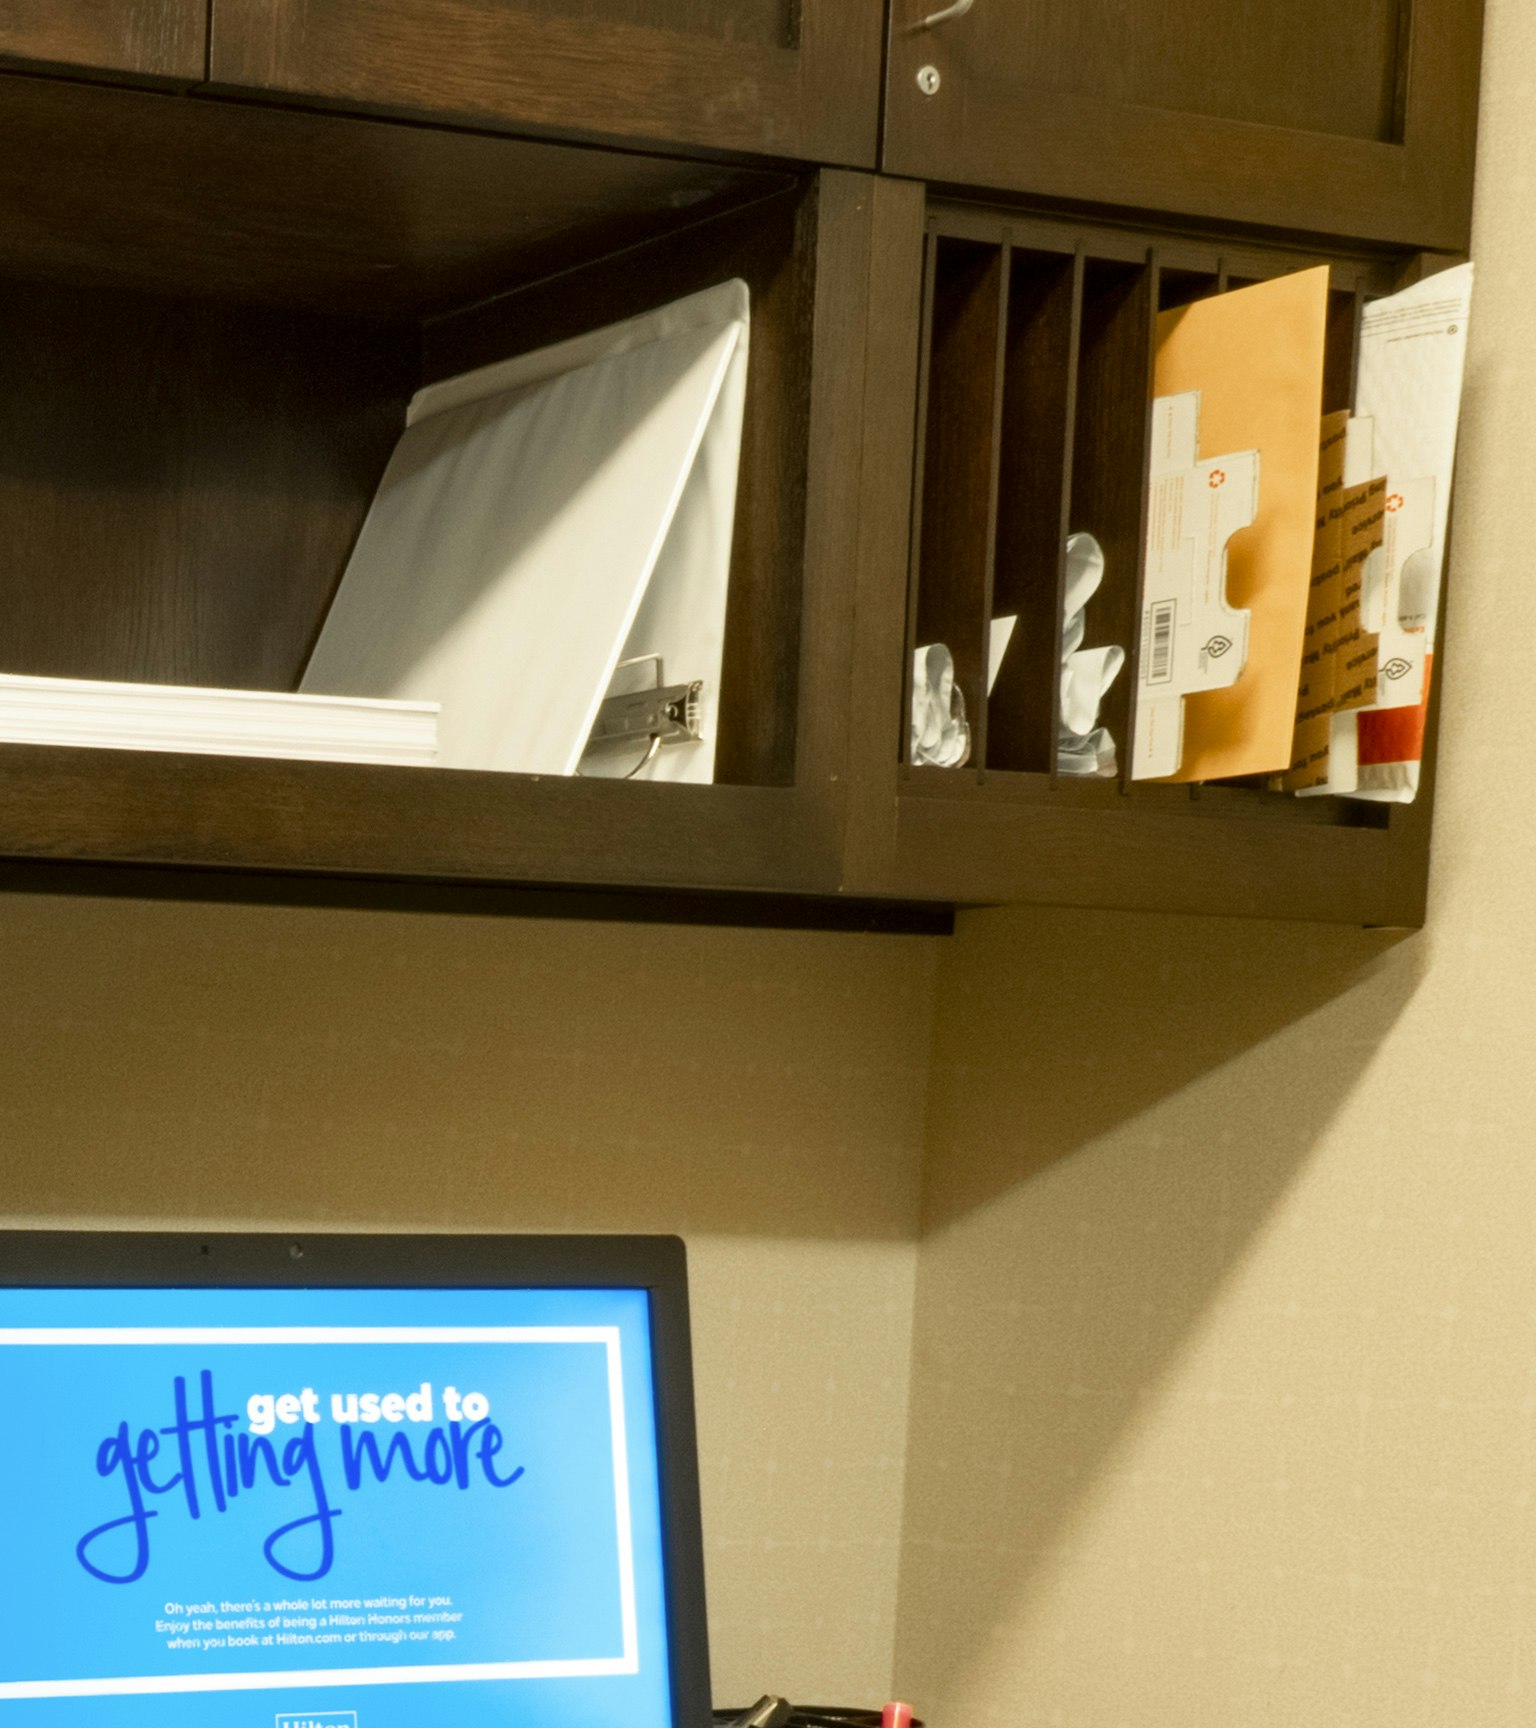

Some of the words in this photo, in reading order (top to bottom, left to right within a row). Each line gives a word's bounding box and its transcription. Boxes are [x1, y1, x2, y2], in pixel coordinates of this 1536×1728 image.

[247, 1387, 320, 1435] get
[331, 1382, 432, 1423] used
[444, 1386, 490, 1422] to
[76, 1368, 342, 1584] getting
[340, 1416, 525, 1490] more
[165, 1602, 183, 1614] Oh
[186, 1601, 217, 1617] yeah,
[264, 1602, 271, 1612] a
[273, 1599, 308, 1611] whole
[311, 1598, 327, 1610] lot
[330, 1600, 361, 1609] more
[364, 1596, 406, 1610] waiting
[409, 1595, 427, 1607] for
[429, 1597, 453, 1609] you.
[155, 1620, 190, 1635] Enjoy
[192, 1619, 213, 1631] the
[216, 1617, 265, 1630] benefits
[268, 1616, 280, 1629] of
[283, 1617, 317, 1630] being
[319, 1617, 327, 1627] a
[330, 1614, 365, 1626] Hilton
[368, 1613, 411, 1625] Honors
[414, 1612, 463, 1624] member
[167, 1637, 200, 1649] when
[203, 1639, 225, 1651] you
[228, 1635, 258, 1647] book
[261, 1635, 273, 1646] at
[276, 1633, 342, 1646] Hilton.com
[345, 1632, 356, 1642] or
[359, 1629, 406, 1644] through
[409, 1629, 429, 1640] our
[432, 1630, 456, 1642] app.
